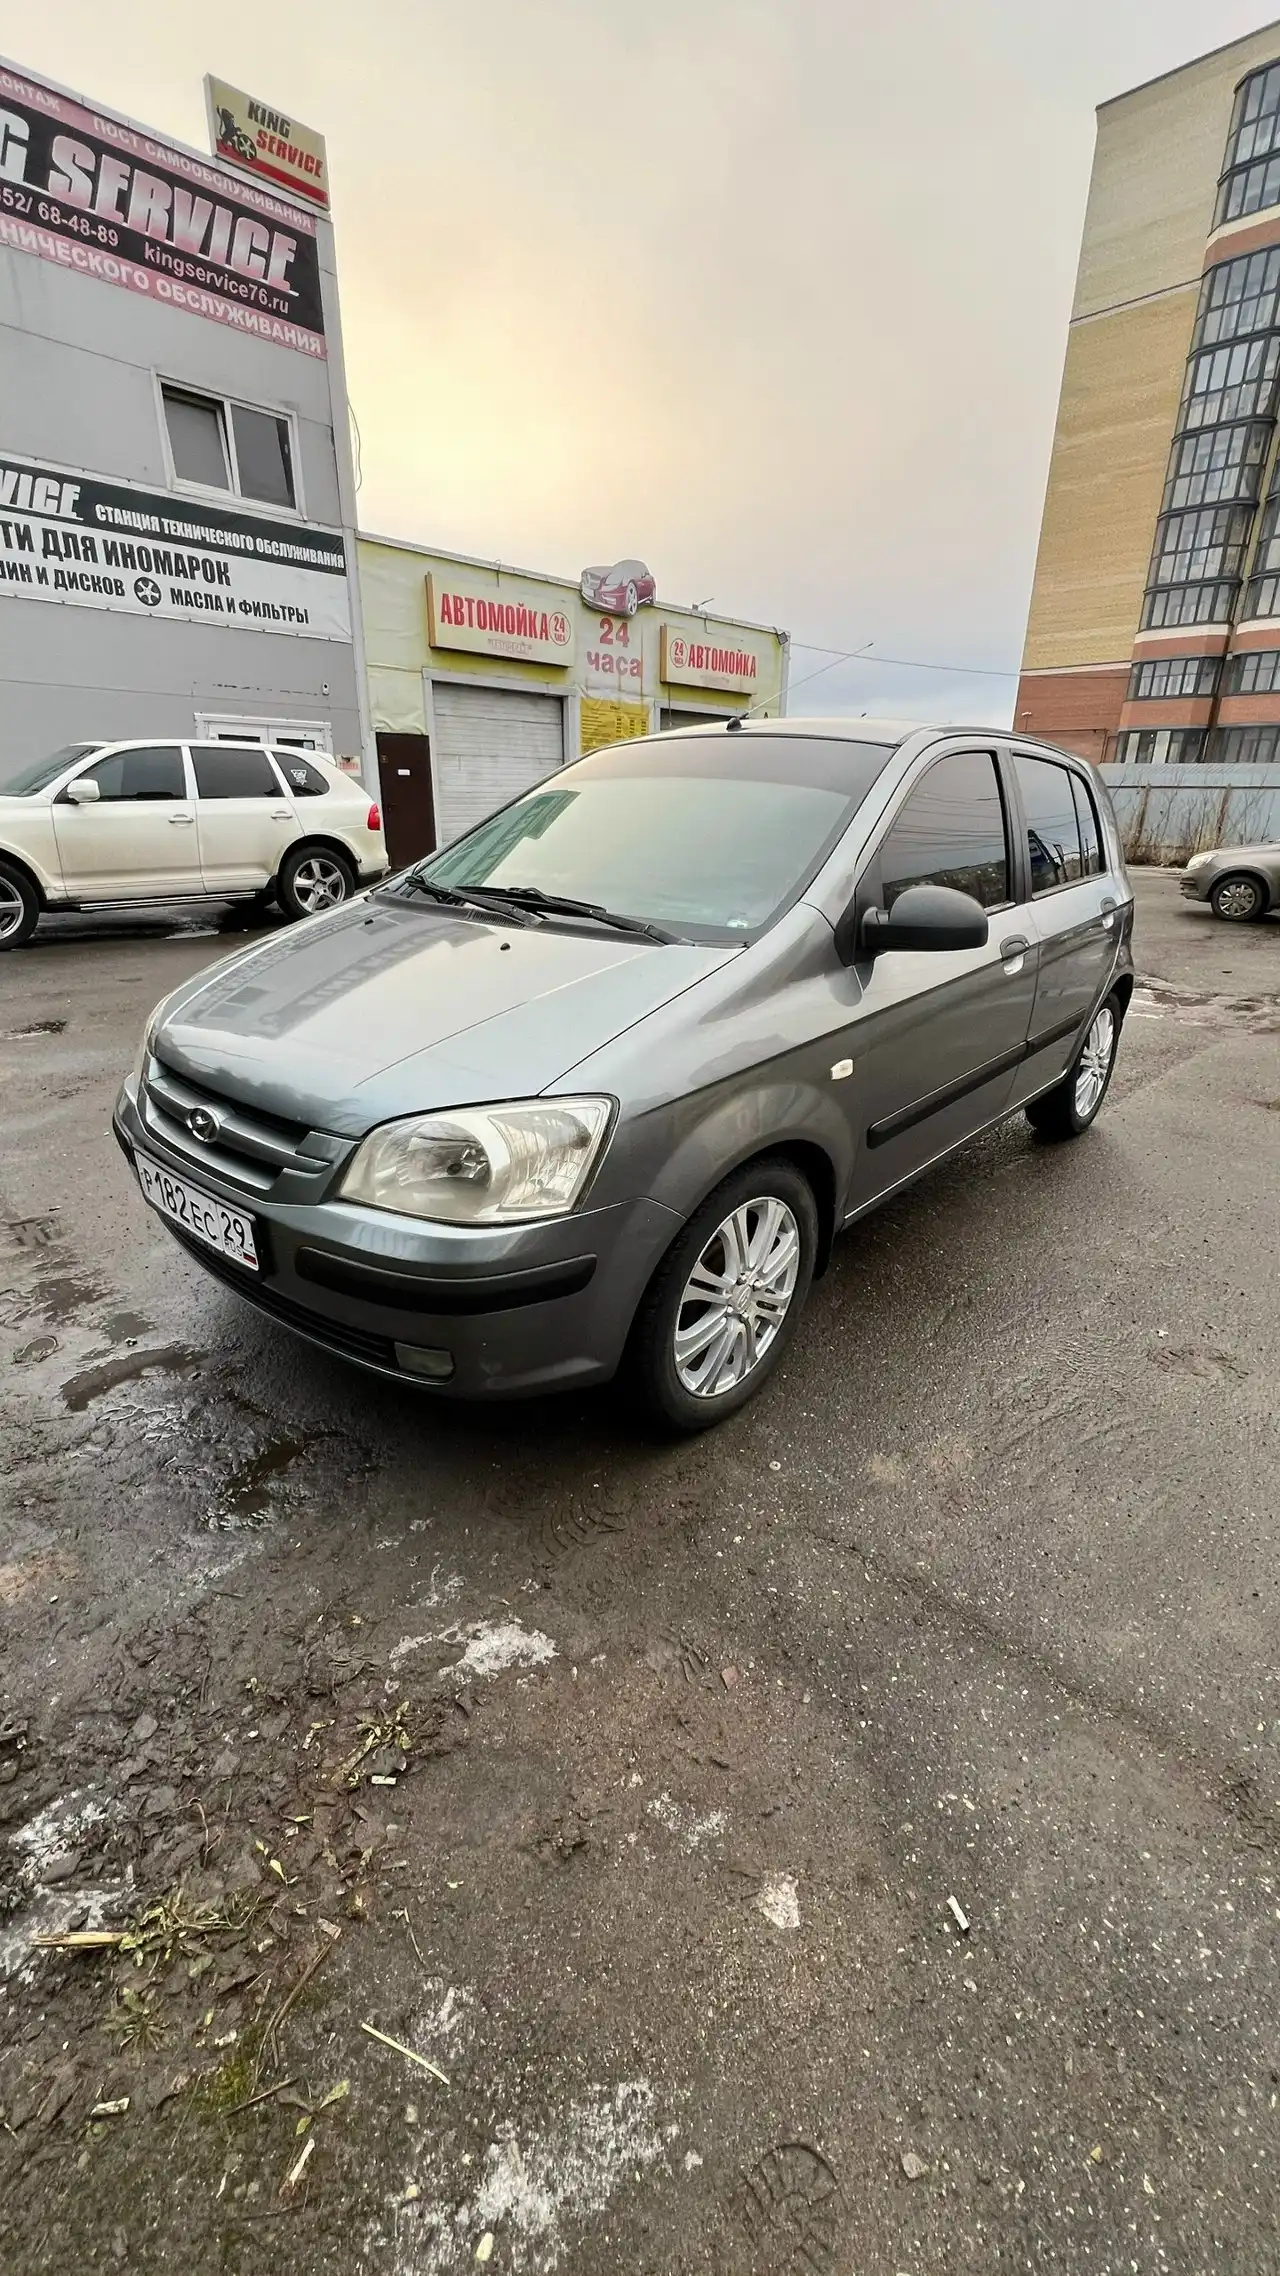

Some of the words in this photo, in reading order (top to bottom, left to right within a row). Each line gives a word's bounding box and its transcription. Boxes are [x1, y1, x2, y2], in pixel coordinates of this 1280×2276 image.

[248, 100, 291, 138] KING
[256, 129, 323, 178] SERVICE
[92, 116, 138, 149] ПОСТ
[145, 138, 313, 230] САМООБСЛУЖИВАНИЯ
[48, 134, 299, 297] SERVICE
[0, 187, 33, 213] 52/
[38, 200, 119, 247] 68-48-89
[144, 240, 289, 315] kingservice76.ru
[0, 221, 149, 289] НИЧЕСКОГО
[156, 278, 322, 353] ОБСЛУЖИВАНИЯ
[0, 520, 35, 552] ТИ
[42, 528, 98, 563] ДЛЯ
[102, 538, 232, 587] ИНОМАРОК
[95, 503, 161, 532] СТАНЦИЯ
[161, 518, 254, 551] ТЕХНИЧЕСКОГО
[256, 539, 345, 569] ОБСЛУЖИВАНИЯ
[36, 566, 49, 585] И
[54, 568, 125, 597] ДИСКОВ
[170, 587, 224, 613] МАСЛА
[227, 598, 236, 614] И
[238, 598, 310, 625] ФИЛЬТРЫ
[441, 593, 549, 642] АВТОМОЙКА
[553, 615, 566, 633] 24
[599, 616, 630, 649] 24
[674, 641, 684, 656] 24
[586, 650, 642, 678] часа
[687, 644, 757, 678] АВТОМОЙКА
[221, 1211, 246, 1249] 29
[224, 1239, 243, 1257] RUS
